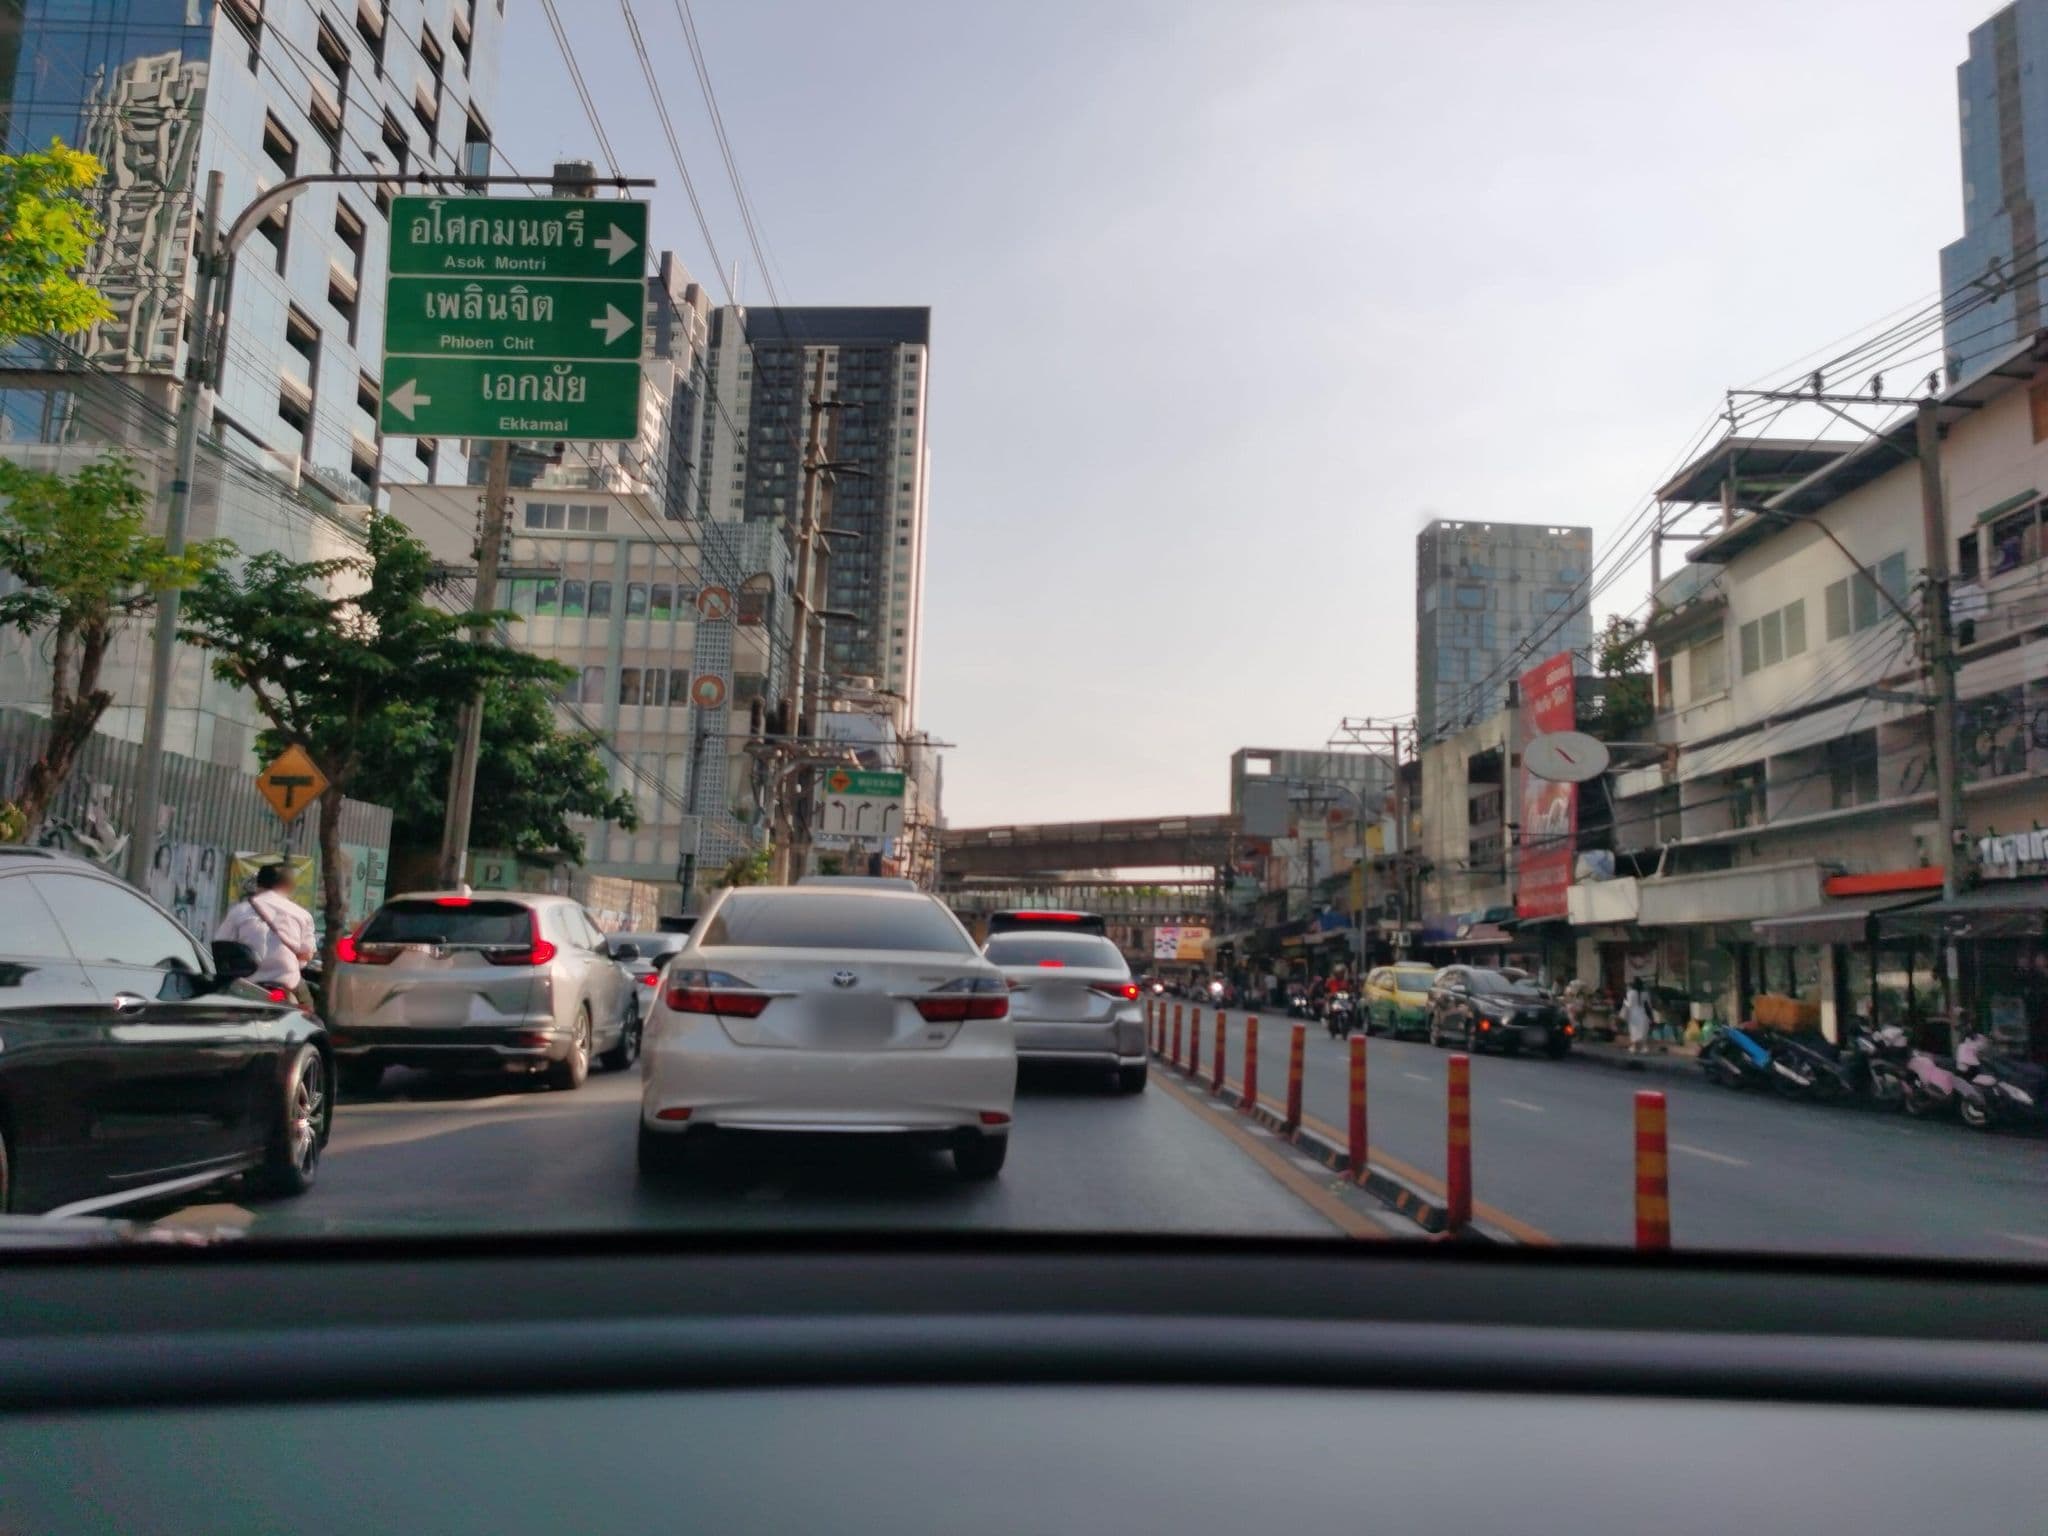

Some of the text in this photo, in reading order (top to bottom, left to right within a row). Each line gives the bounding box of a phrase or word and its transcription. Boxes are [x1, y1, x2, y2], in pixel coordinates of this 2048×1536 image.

[411, 201, 584, 246] อโศกมนตรี
[445, 256, 546, 270] Asok Montri
[425, 283, 553, 321] เพลินจิต
[440, 335, 534, 349] Phloen Chit
[482, 364, 586, 402] เอกมัย
[499, 417, 568, 432] Ekkamai
